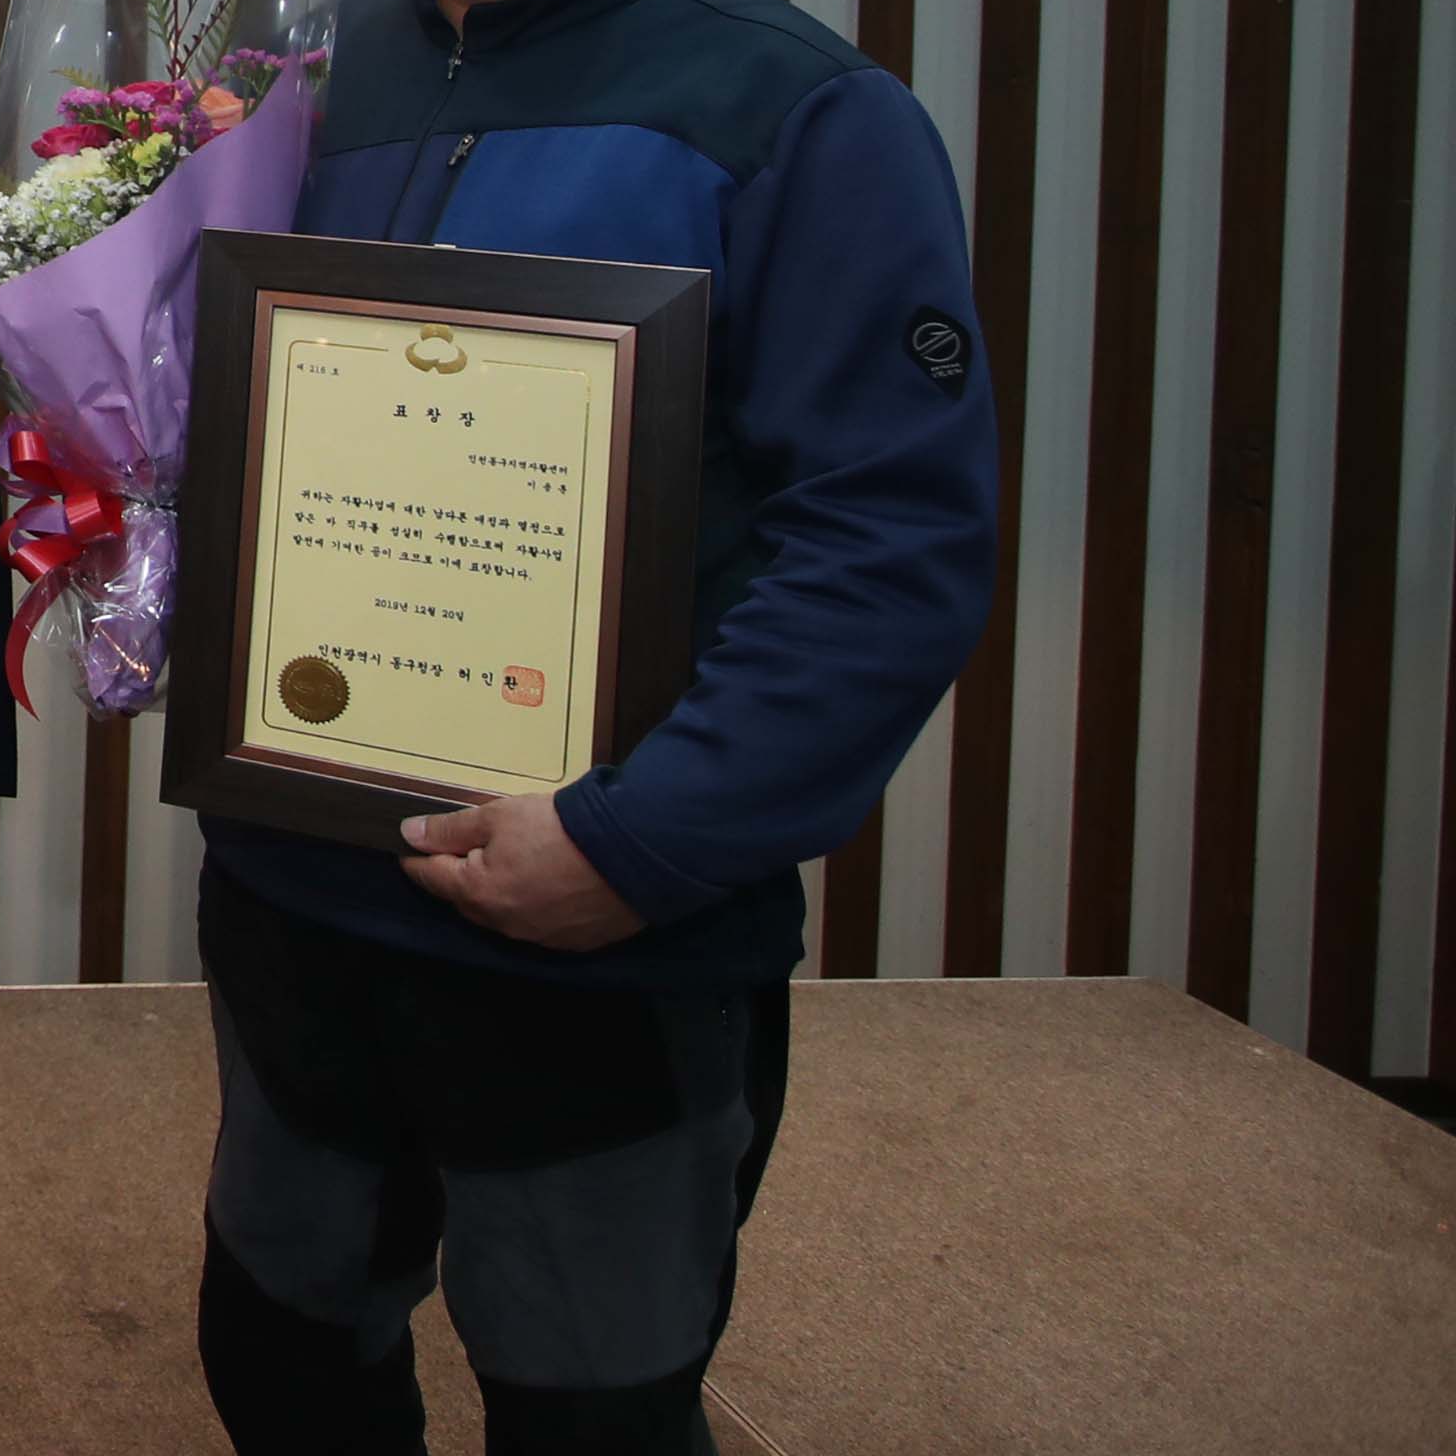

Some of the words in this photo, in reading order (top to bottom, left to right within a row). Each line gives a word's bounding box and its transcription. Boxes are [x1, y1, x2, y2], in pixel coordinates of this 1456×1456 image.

[392, 405, 408, 418] 표
[426, 407, 442, 423] 창
[458, 411, 475, 427] 장
